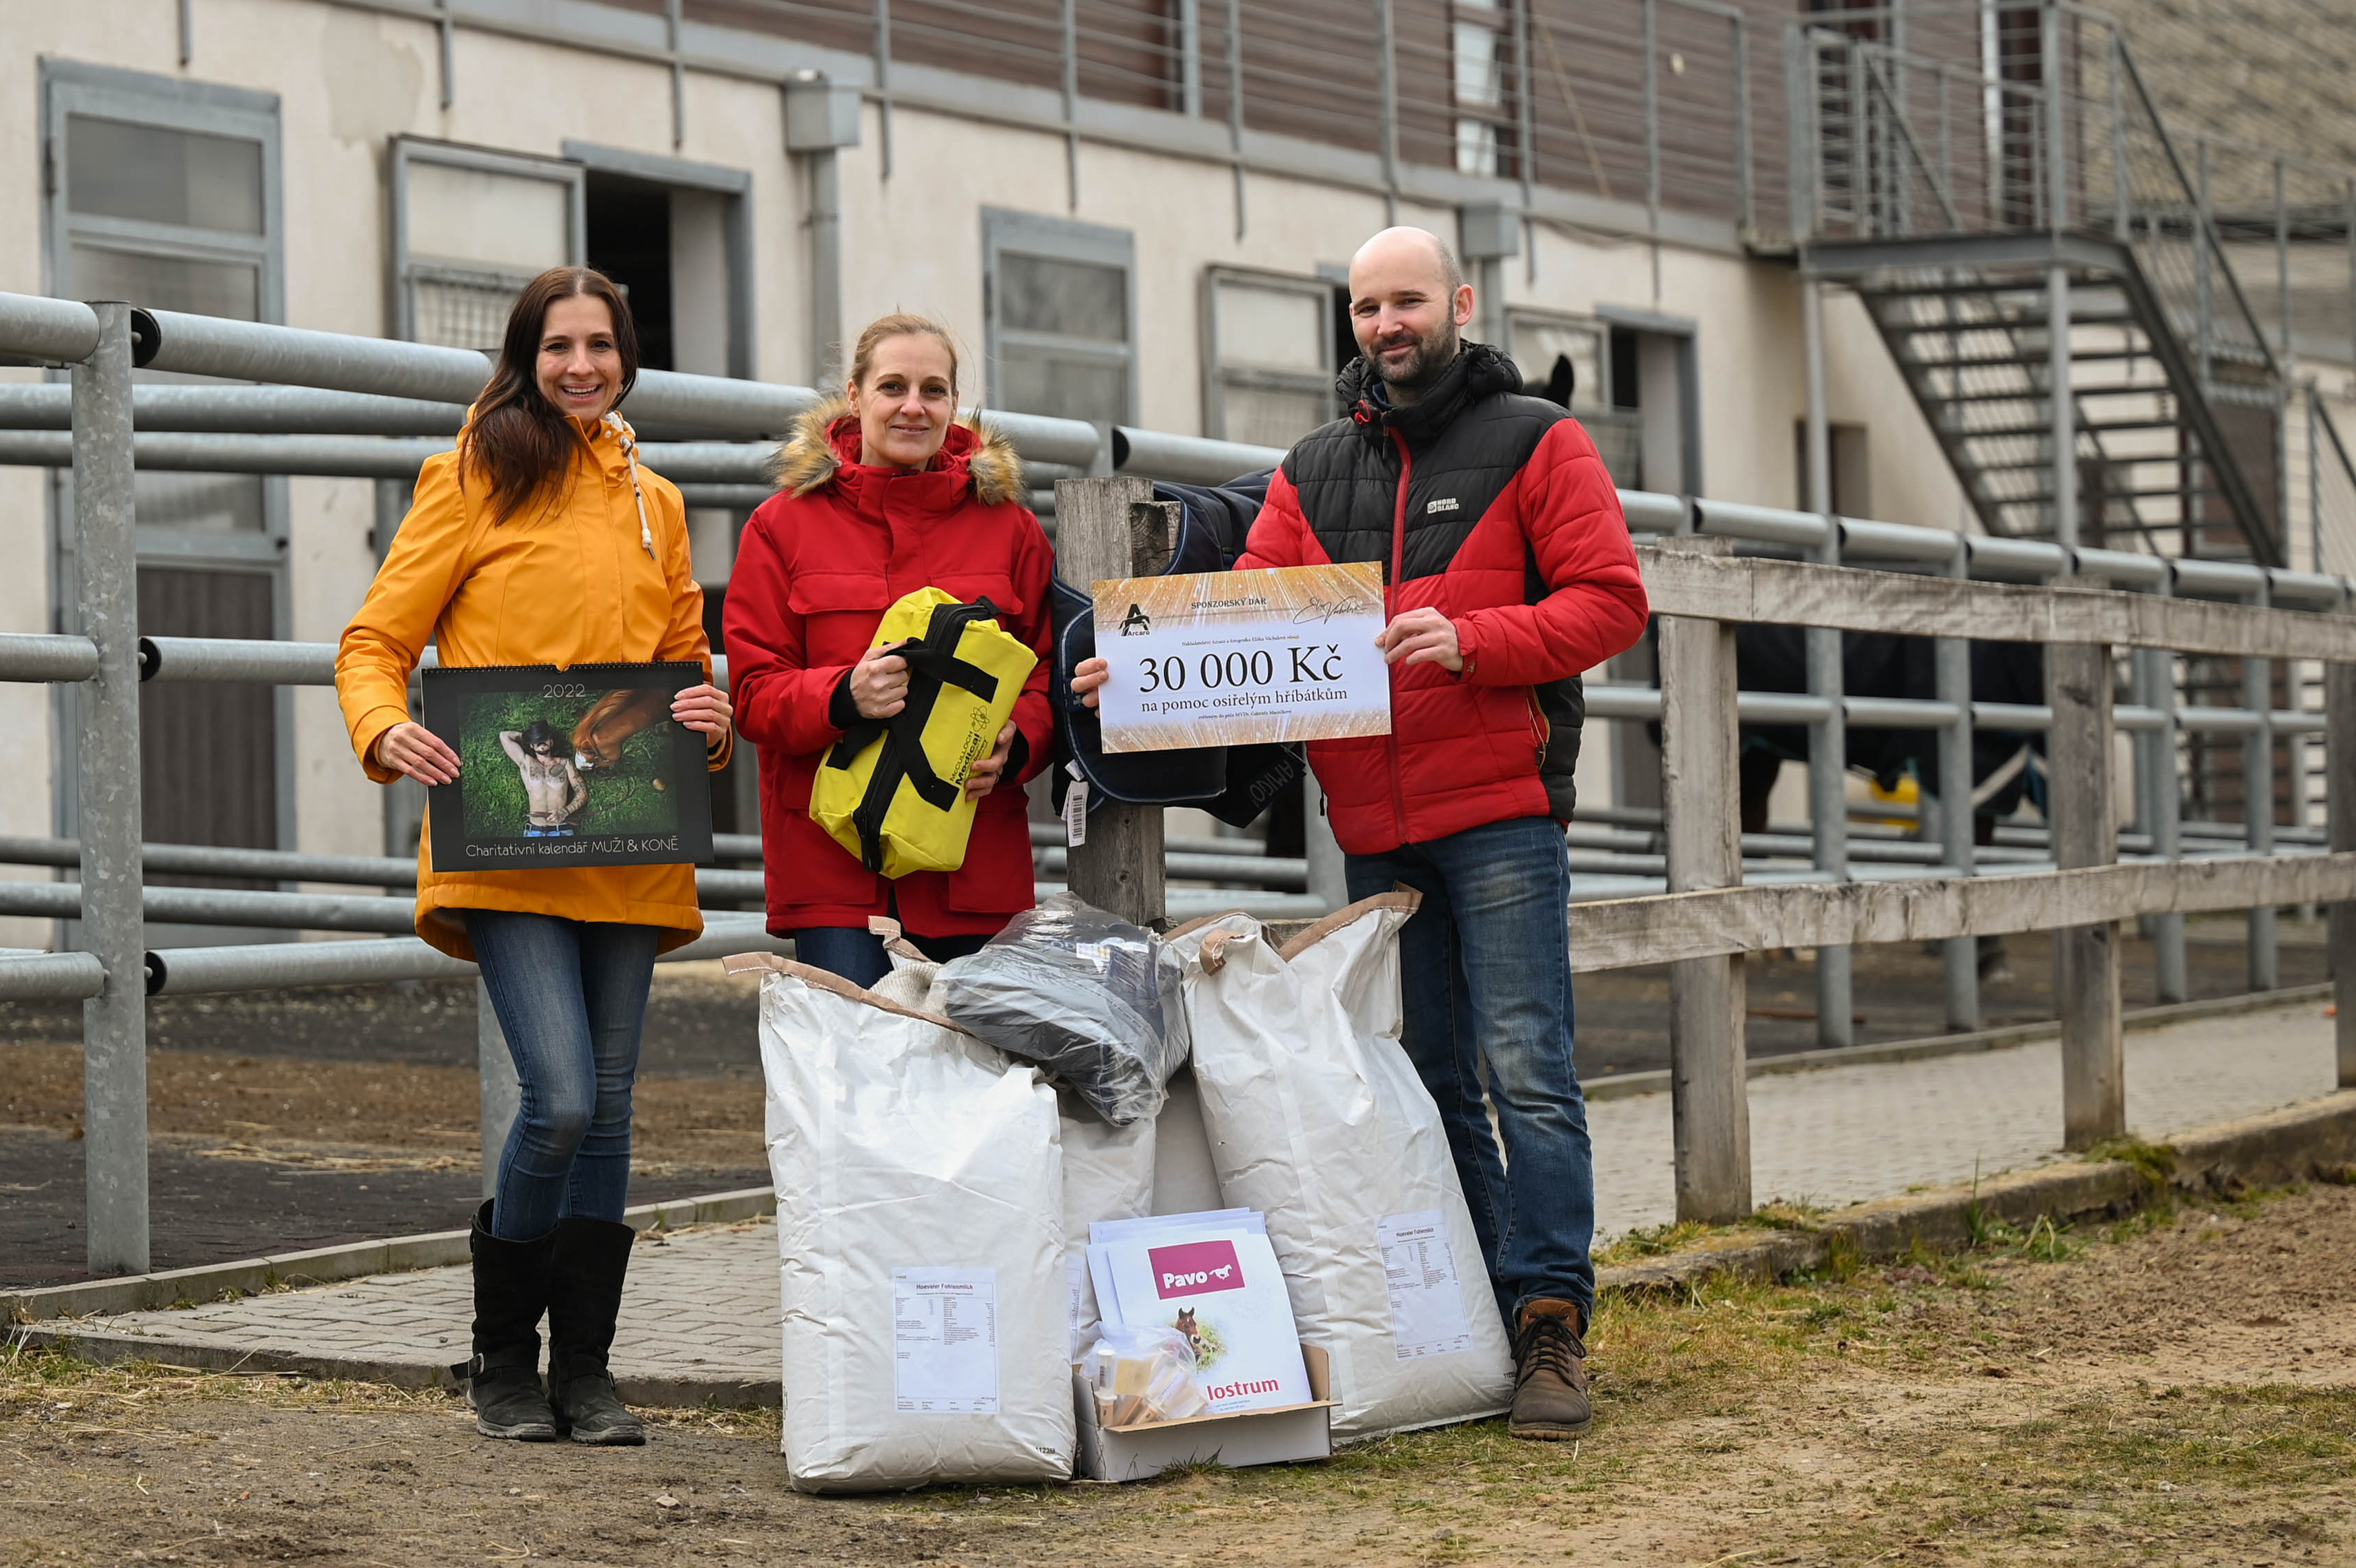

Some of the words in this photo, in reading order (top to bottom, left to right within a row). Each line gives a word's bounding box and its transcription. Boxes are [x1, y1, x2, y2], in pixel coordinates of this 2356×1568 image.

[1139, 656, 1186, 693] 30
[1200, 650, 1273, 689] 000
[1287, 643, 1343, 683] Kč
[542, 683, 586, 698] 2022
[1141, 700, 1158, 712] na
[1162, 698, 1208, 715] pomoc
[1213, 692, 1271, 709] osiřelým
[1275, 687, 1348, 704] hříbátkům
[955, 733, 979, 785] Medical
[466, 843, 536, 857] Charitativní
[538, 841, 588, 854] kalendář
[591, 836, 624, 853] MUŽI
[627, 839, 638, 852] &
[641, 835, 679, 852] KONĚ
[1163, 1271, 1208, 1289] Pavo
[1207, 1379, 1279, 1400] lostrum
